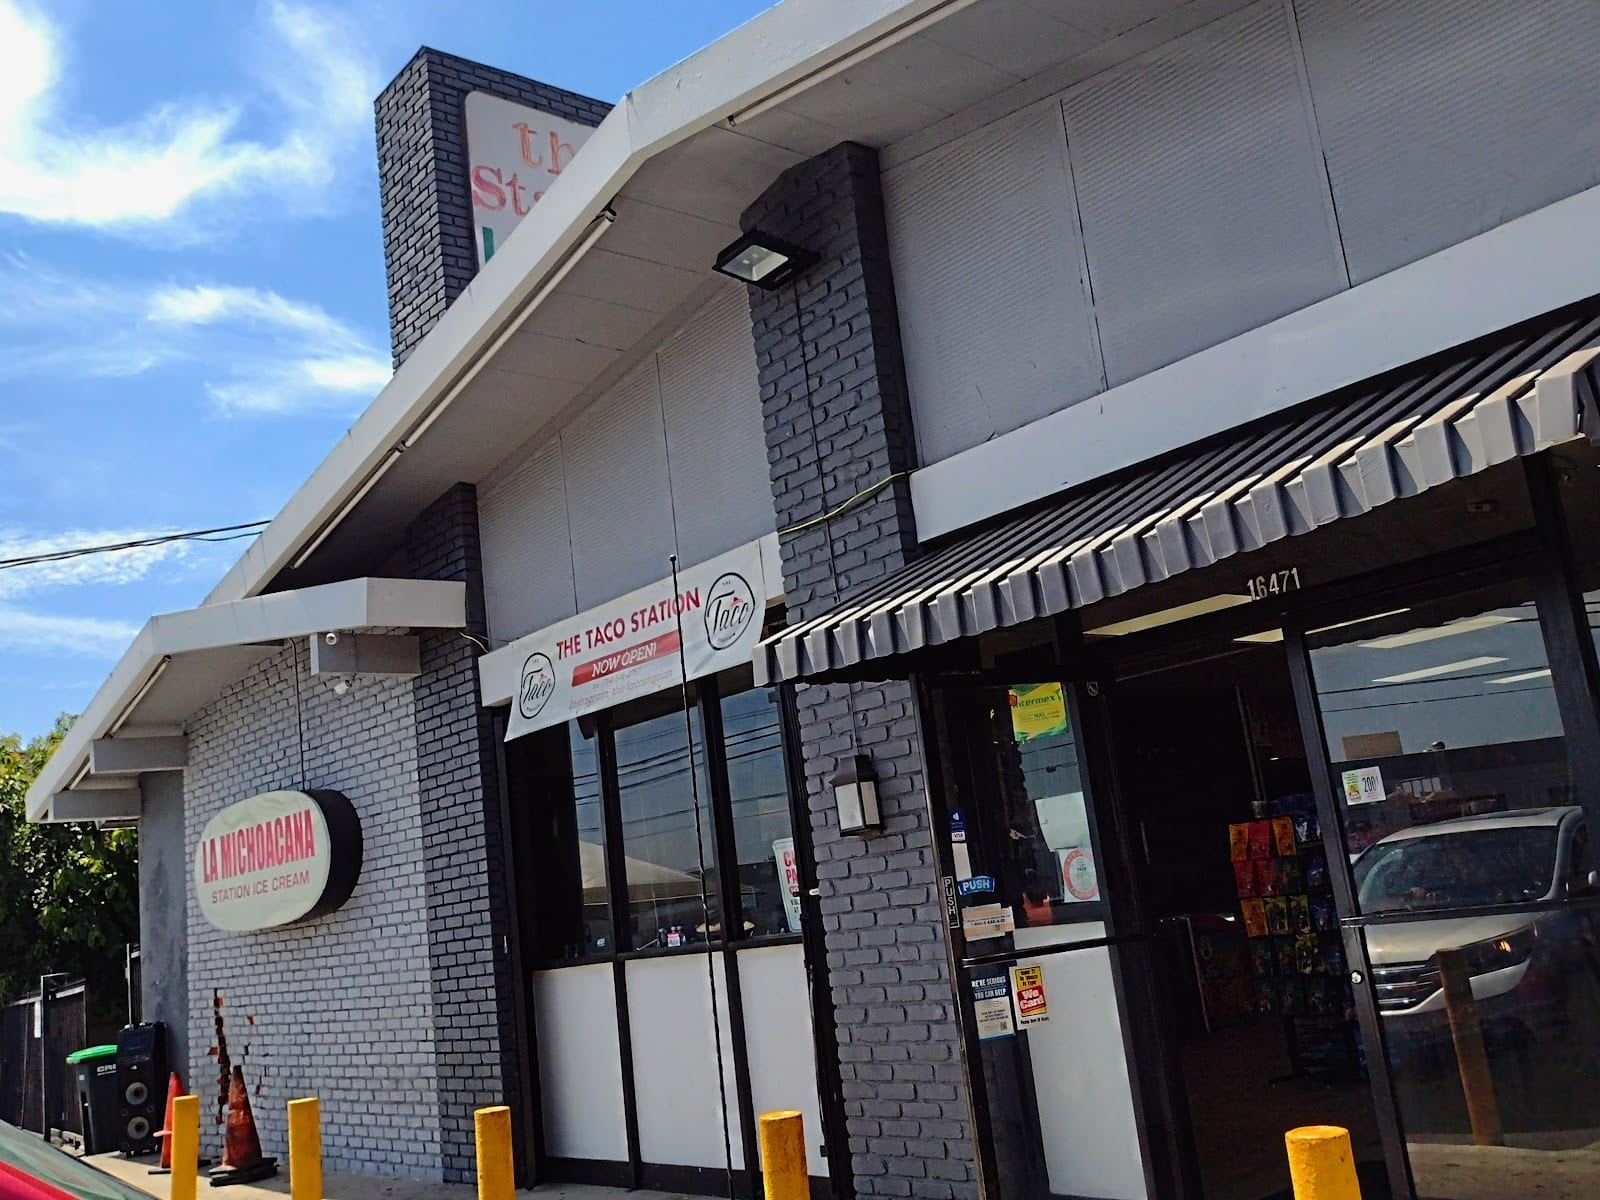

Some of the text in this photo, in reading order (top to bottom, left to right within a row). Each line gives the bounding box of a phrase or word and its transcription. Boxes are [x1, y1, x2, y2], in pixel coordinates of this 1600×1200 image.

[1247, 567, 1300, 600] 16471
[556, 586, 701, 660] THE TACO STATION
[707, 590, 748, 635] Taco
[591, 654, 620, 678] NOW
[621, 642, 657, 666] OPEN!
[522, 667, 551, 704] Taco
[1015, 695, 1056, 709] ntermex
[202, 808, 316, 883] LA MICHOACANA
[212, 870, 310, 904] STATION ICE CREAM
[944, 878, 956, 916] PUSH
[962, 879, 990, 891] PUSH
[974, 991, 984, 1000] YOU
[984, 989, 995, 998] CAN
[986, 975, 1006, 986] SERIOUS
[1021, 988, 1039, 999] We
[1020, 995, 1045, 1010] Card
